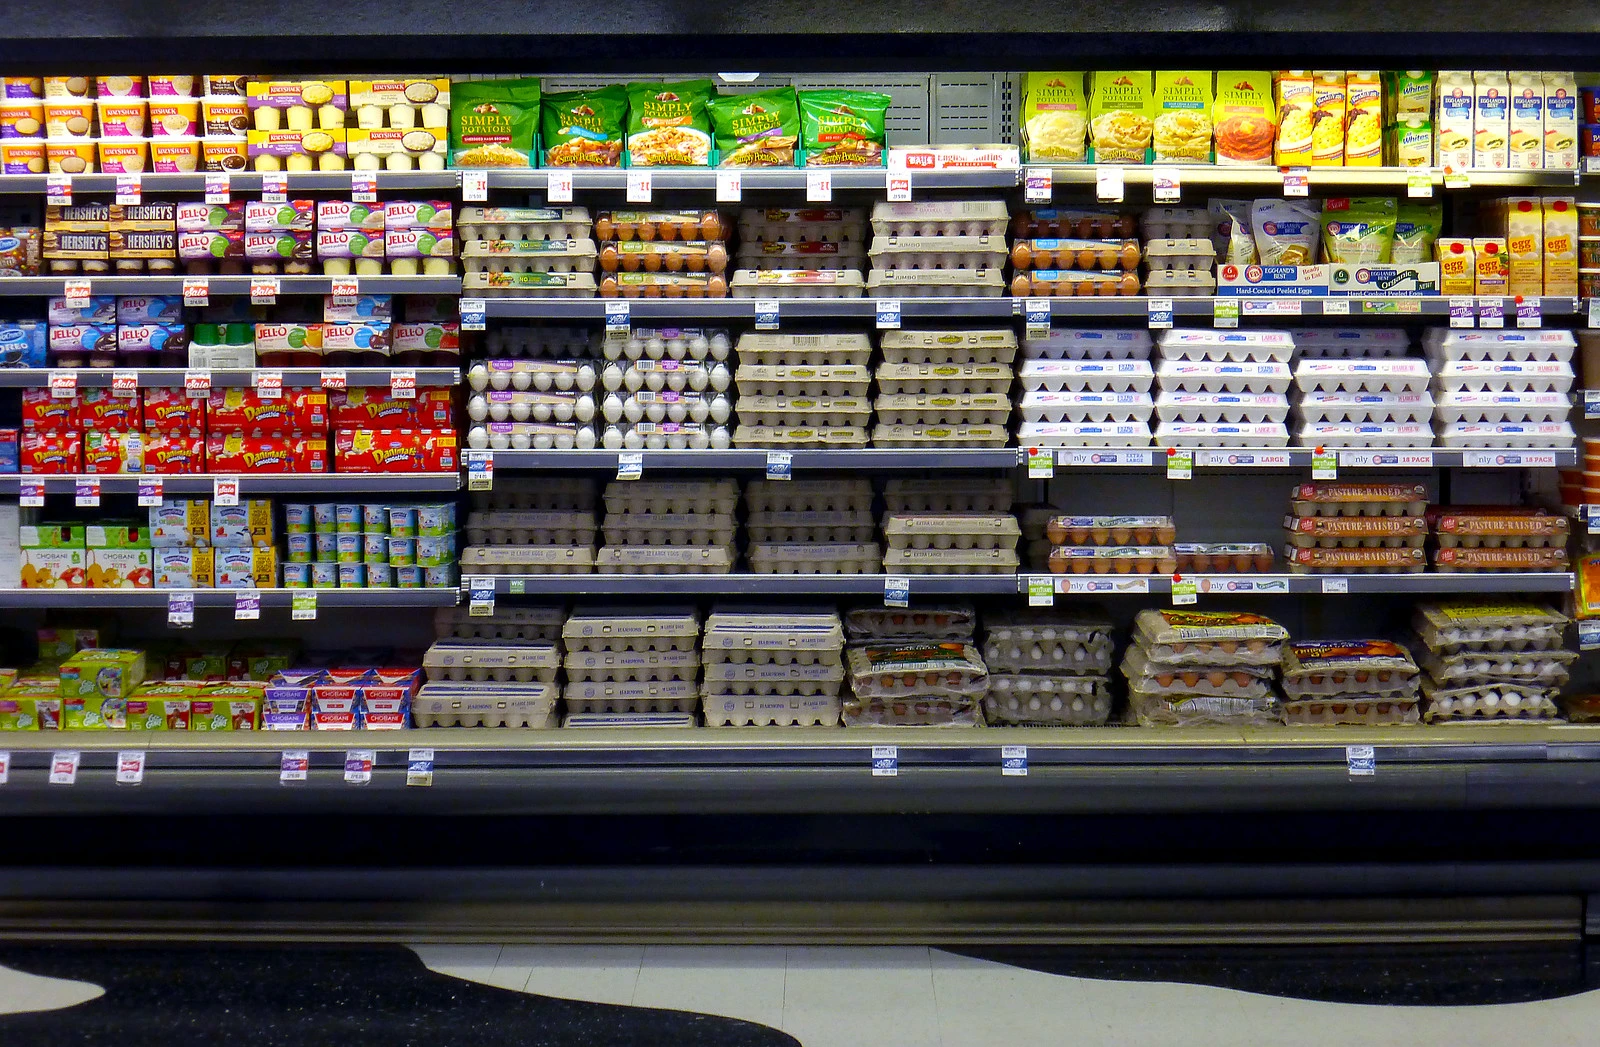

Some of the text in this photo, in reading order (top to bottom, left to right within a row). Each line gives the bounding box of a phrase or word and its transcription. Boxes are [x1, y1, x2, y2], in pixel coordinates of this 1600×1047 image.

[1103, 87, 1143, 95] SIMPLY
[1164, 87, 1203, 95] SIMPLY
[1404, 85, 1428, 94] Whites
[644, 102, 692, 111] SIMPLY
[462, 116, 511, 124] SIMPLY
[732, 112, 779, 129] SIMPLY
[818, 116, 866, 126] SIMPLY
[734, 122, 780, 136] POTATOES
[818, 126, 865, 134] POTATOES
[1403, 134, 1428, 144] Whites
[560, 152, 579, 164] Simply
[734, 152, 778, 164] Simply Potatoes
[822, 152, 866, 163] Simply Potatoes
[64, 207, 107, 220] HERSHEY'S
[128, 206, 172, 219] HERSHEY'S
[62, 235, 106, 250] HERSHEY'S
[128, 235, 172, 249] HERSHEY'S
[1512, 240, 1530, 250] egg
[1548, 240, 1566, 250] egg
[1302, 266, 1319, 275] Ready
[1444, 261, 1463, 271] egg
[1479, 260, 1497, 271] egg
[1312, 271, 1322, 279] Eat!
[1382, 270, 1412, 289] Organic
[67, 288, 90, 298] Sale
[184, 288, 207, 297] Sale
[252, 287, 274, 296] Sale
[333, 286, 356, 296] Sale
[52, 380, 75, 388] Sale
[114, 380, 136, 390] Sale
[186, 380, 208, 389] Sale
[258, 380, 281, 388] Sale
[322, 379, 344, 387] Sale
[392, 379, 414, 388] Sale
[36, 403, 70, 418] Danimals
[95, 404, 129, 418] Danimals
[156, 405, 191, 419] Danimals
[244, 405, 287, 422] Danimals
[366, 402, 409, 418] Danimals
[379, 408, 402, 417] smoothie
[256, 411, 279, 421] smoothie
[34, 450, 68, 463] Danimals
[86, 451, 118, 463] Danimals
[157, 450, 192, 463] Danimals
[243, 452, 286, 468] Danimals
[372, 448, 416, 465] Danimals
[385, 455, 408, 464] smoothie
[256, 458, 279, 467] smoothie
[219, 486, 235, 495] Sale
[1328, 488, 1400, 496] PASTURE-RAISED
[1327, 522, 1400, 531] PASTURE-RAISED
[1469, 521, 1542, 529] PASTURE-RAISED
[1326, 552, 1398, 561] PASTURE-RAISED
[1468, 553, 1540, 561] PASTURE-RAISED
